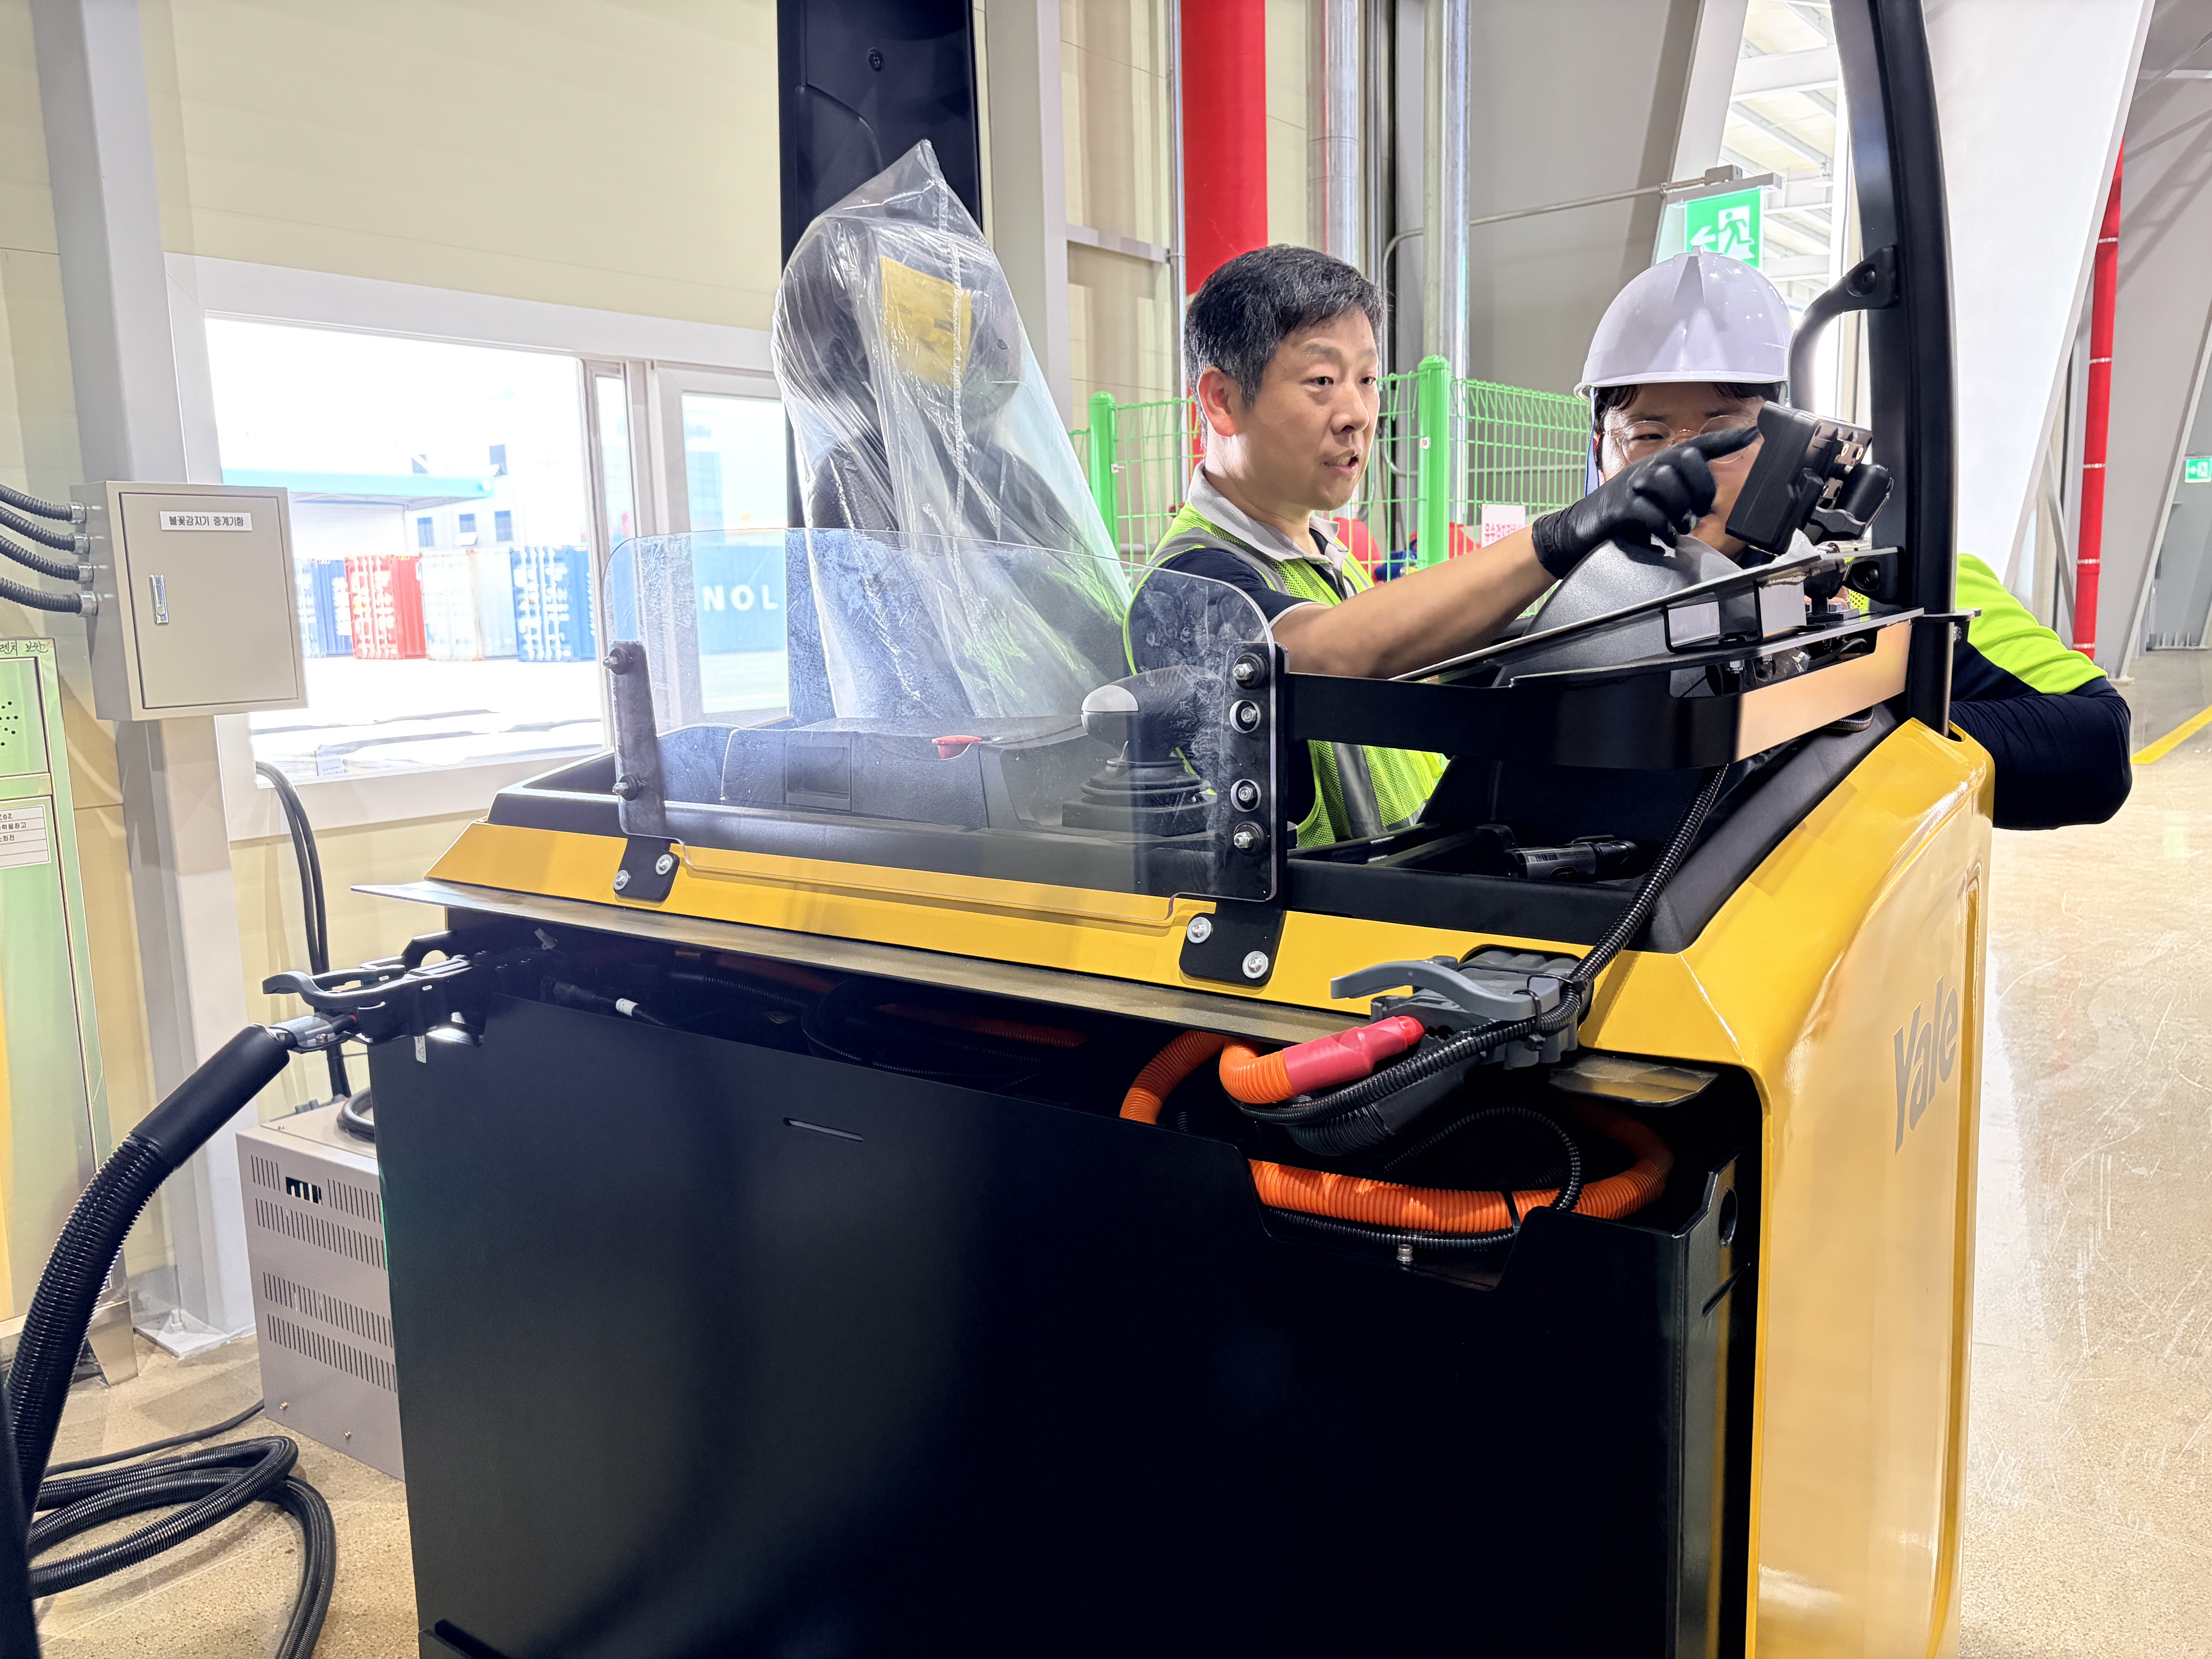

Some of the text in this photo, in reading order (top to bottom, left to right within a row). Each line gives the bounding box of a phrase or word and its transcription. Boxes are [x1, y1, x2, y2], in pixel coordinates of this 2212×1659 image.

[169, 515, 244, 527] 불꽃감지기 중계기함
[0, 822, 26, 831] 학물창고
[1894, 974, 1958, 1155] Yale
